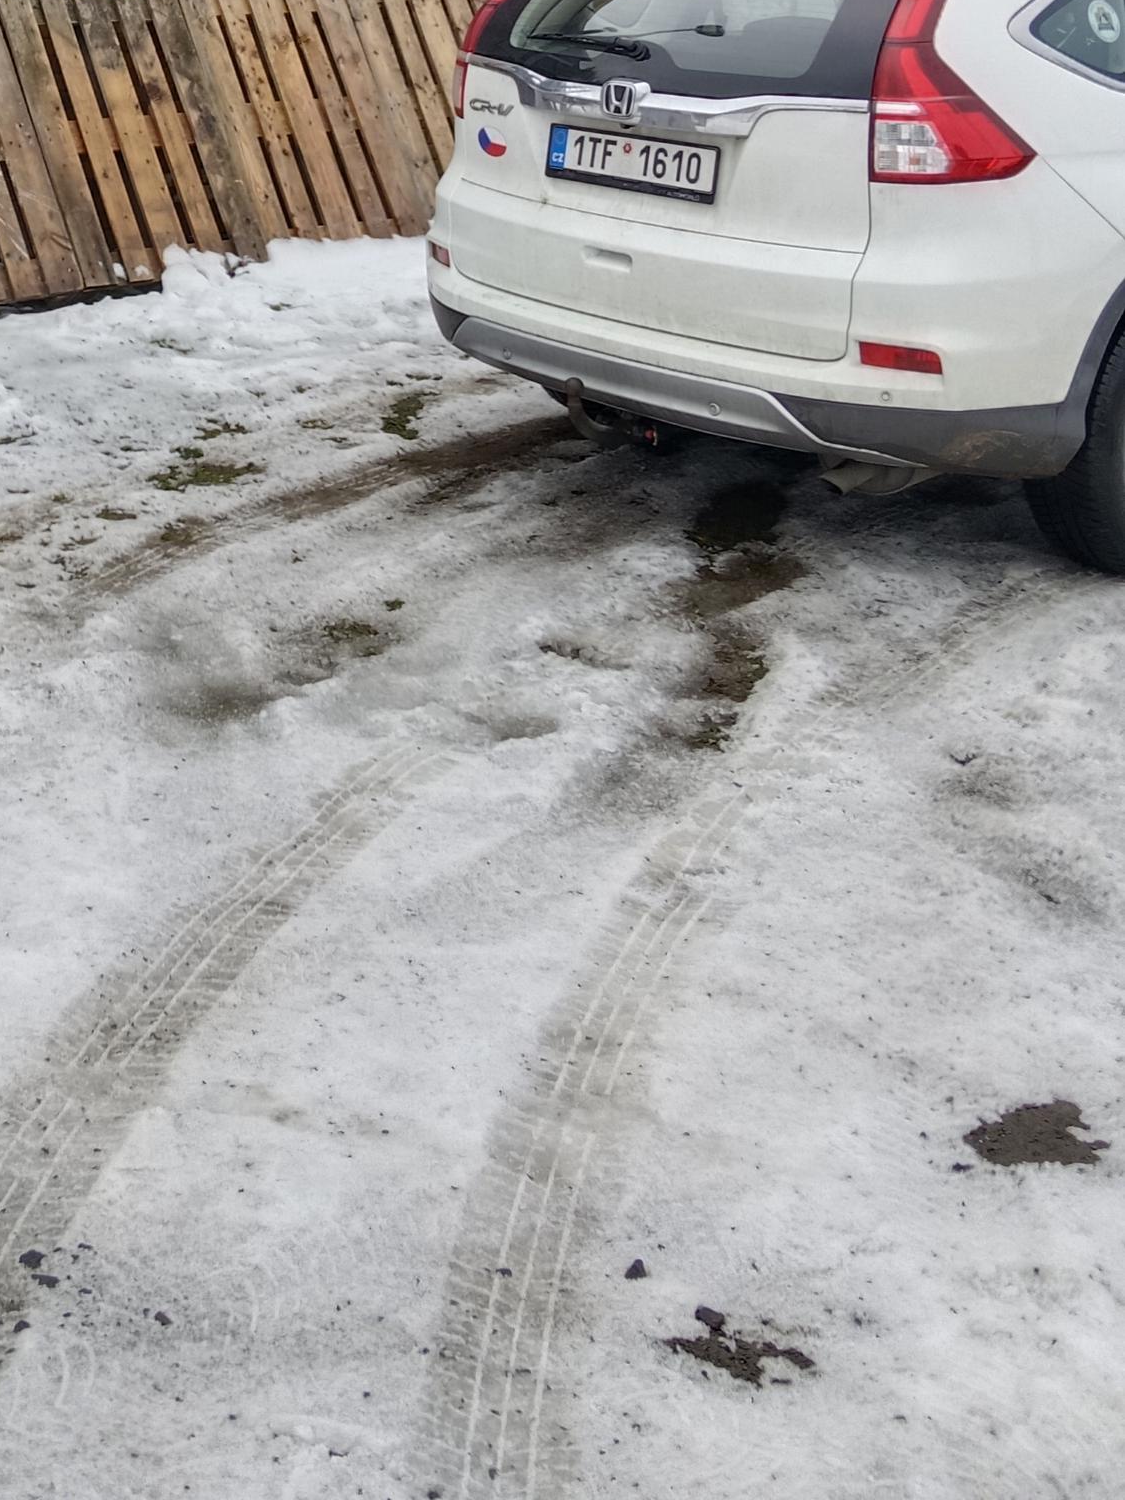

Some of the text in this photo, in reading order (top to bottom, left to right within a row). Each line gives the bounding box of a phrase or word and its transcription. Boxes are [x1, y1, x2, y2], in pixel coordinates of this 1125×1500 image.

[469, 98, 515, 117] CR-V
[551, 151, 565, 163] CZ
[573, 135, 702, 184] 1TF 1610
